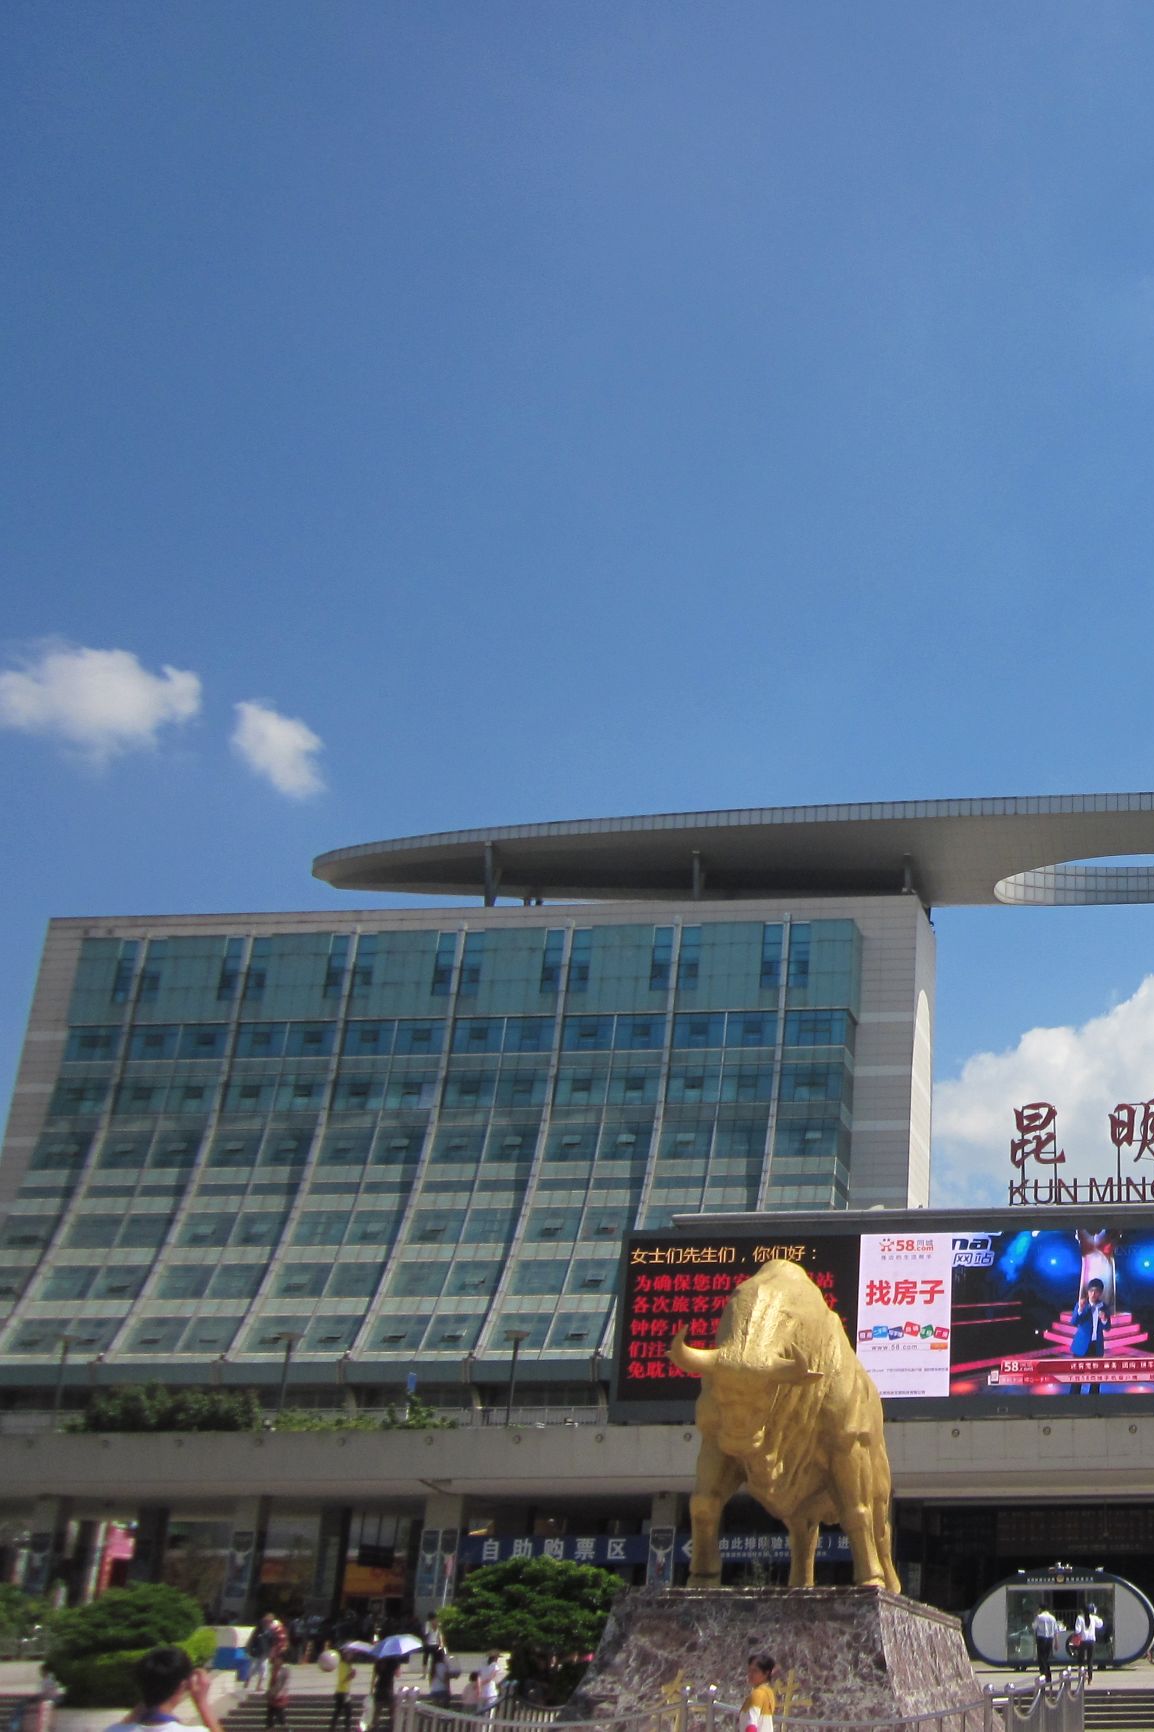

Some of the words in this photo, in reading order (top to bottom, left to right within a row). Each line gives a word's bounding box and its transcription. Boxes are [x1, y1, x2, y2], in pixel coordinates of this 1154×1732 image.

[1009, 1177, 1078, 1205] KUN
[866, 1279, 945, 1306] 找房子
[482, 1537, 627, 1561] 自助购票区
